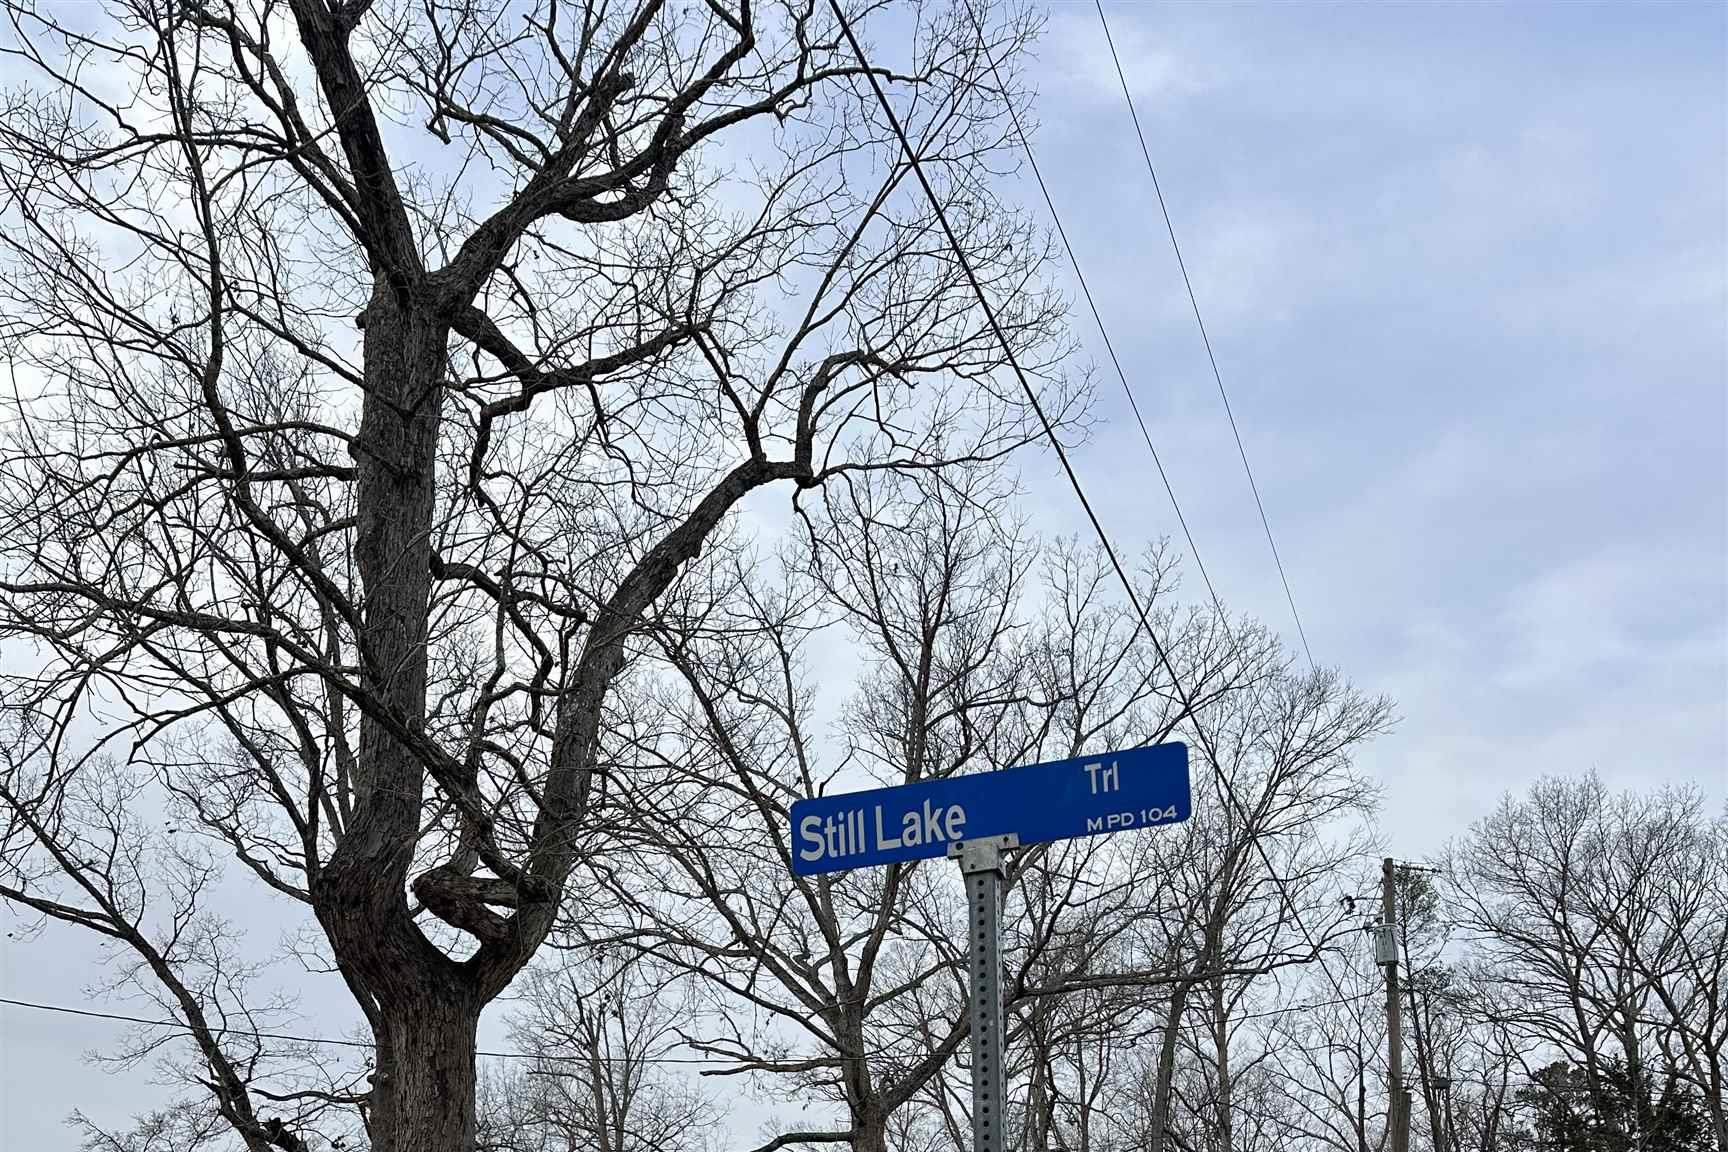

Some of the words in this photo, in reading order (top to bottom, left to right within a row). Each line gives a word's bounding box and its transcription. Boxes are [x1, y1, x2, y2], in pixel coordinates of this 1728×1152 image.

[1084, 761, 1120, 794] Trl
[799, 808, 866, 861] Still
[875, 798, 967, 852] Lake
[1140, 804, 1178, 824] 104
